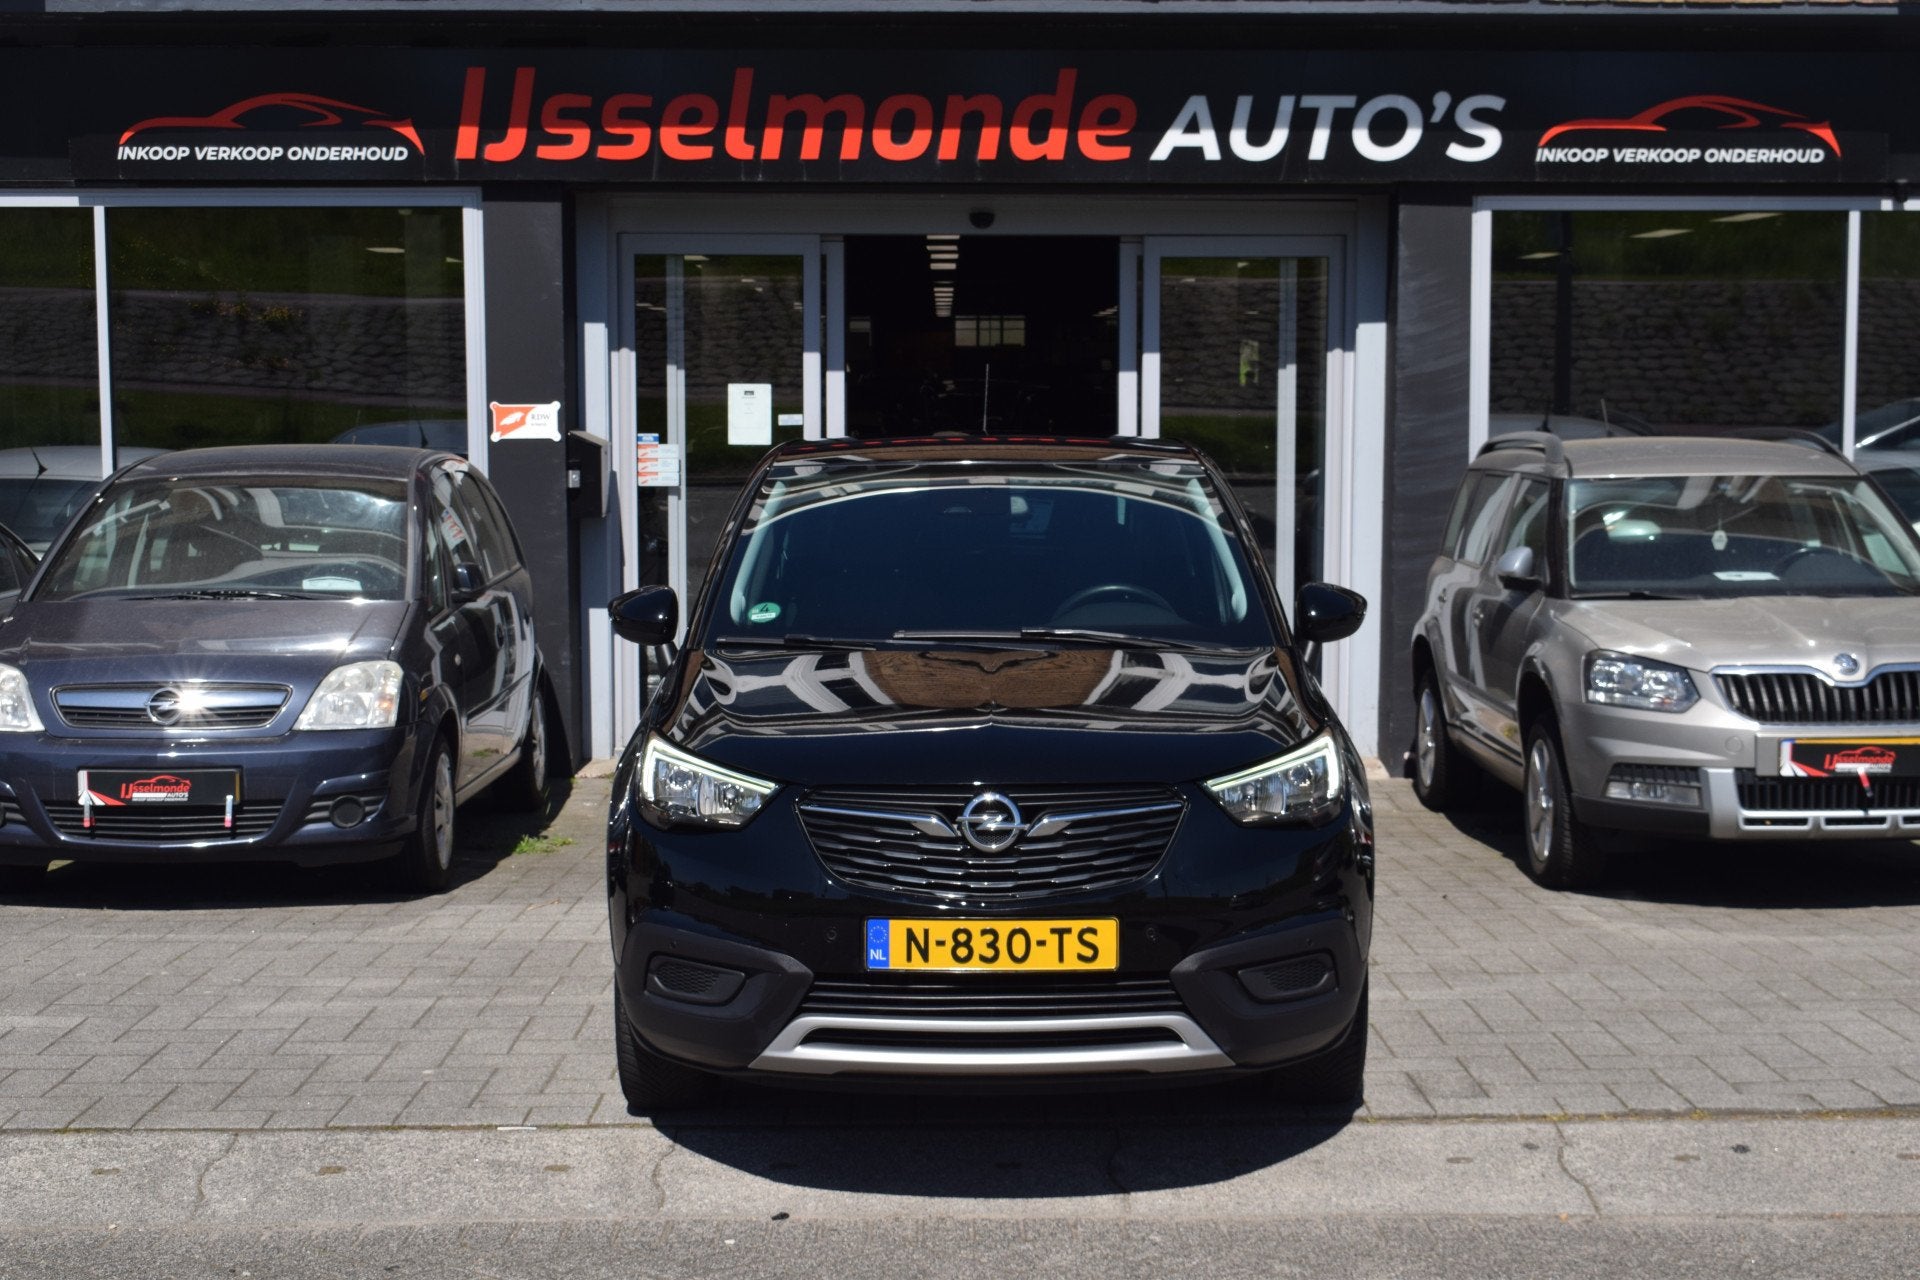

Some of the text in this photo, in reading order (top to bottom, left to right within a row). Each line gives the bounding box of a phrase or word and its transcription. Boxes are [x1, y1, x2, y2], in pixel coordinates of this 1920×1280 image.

[454, 68, 1507, 163] IJsselmonde AUTO'S
[117, 146, 408, 161] INKOOP VERKOOP ONDERHOUD
[1535, 147, 1825, 163] INKOOP VERKOOP ONDERHOUD
[120, 783, 190, 798] IJsselmonde
[906, 927, 1099, 964] N-830-TS
[870, 949, 886, 960] NL
